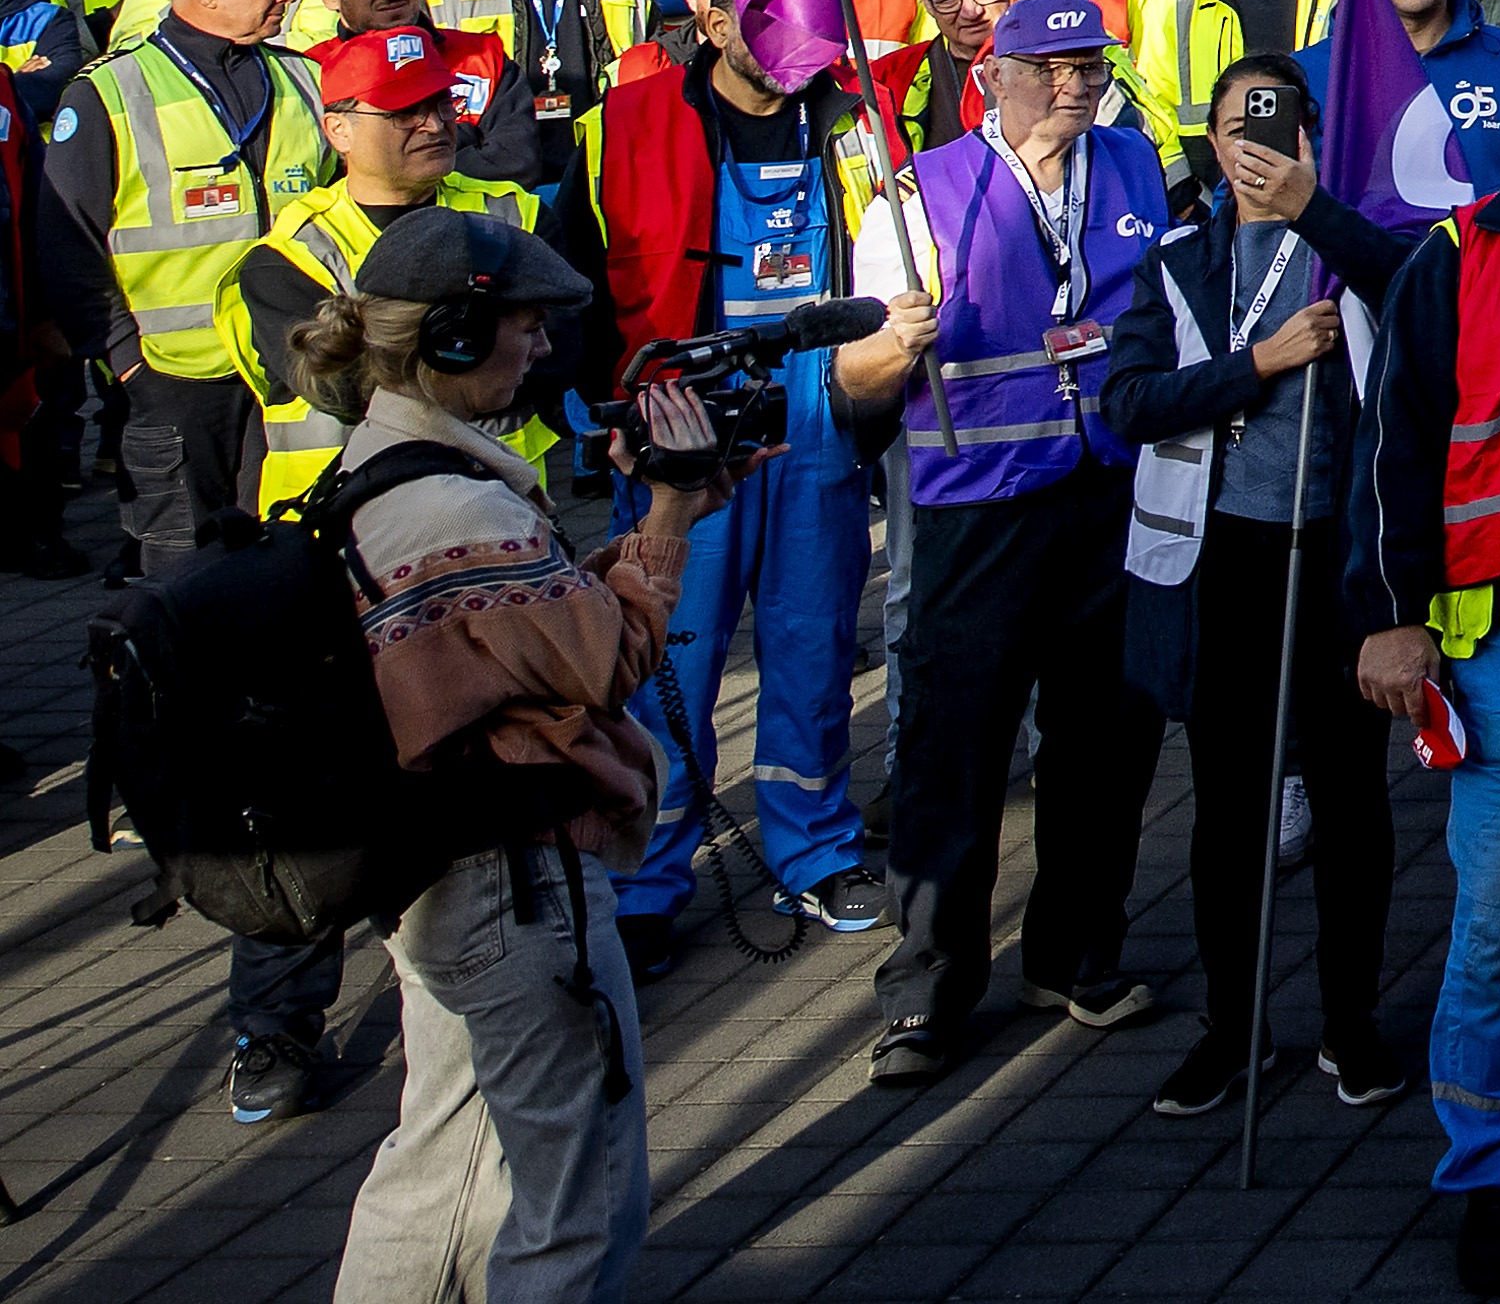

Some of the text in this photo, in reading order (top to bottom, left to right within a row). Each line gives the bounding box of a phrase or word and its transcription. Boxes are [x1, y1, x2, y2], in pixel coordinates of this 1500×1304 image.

[1047, 11, 1086, 30] CNV
[388, 37, 423, 60] FNV
[1450, 86, 1487, 130] 95
[1117, 213, 1154, 238] CNV
[1272, 252, 1288, 273] CNV
[1253, 292, 1268, 314] CNV
